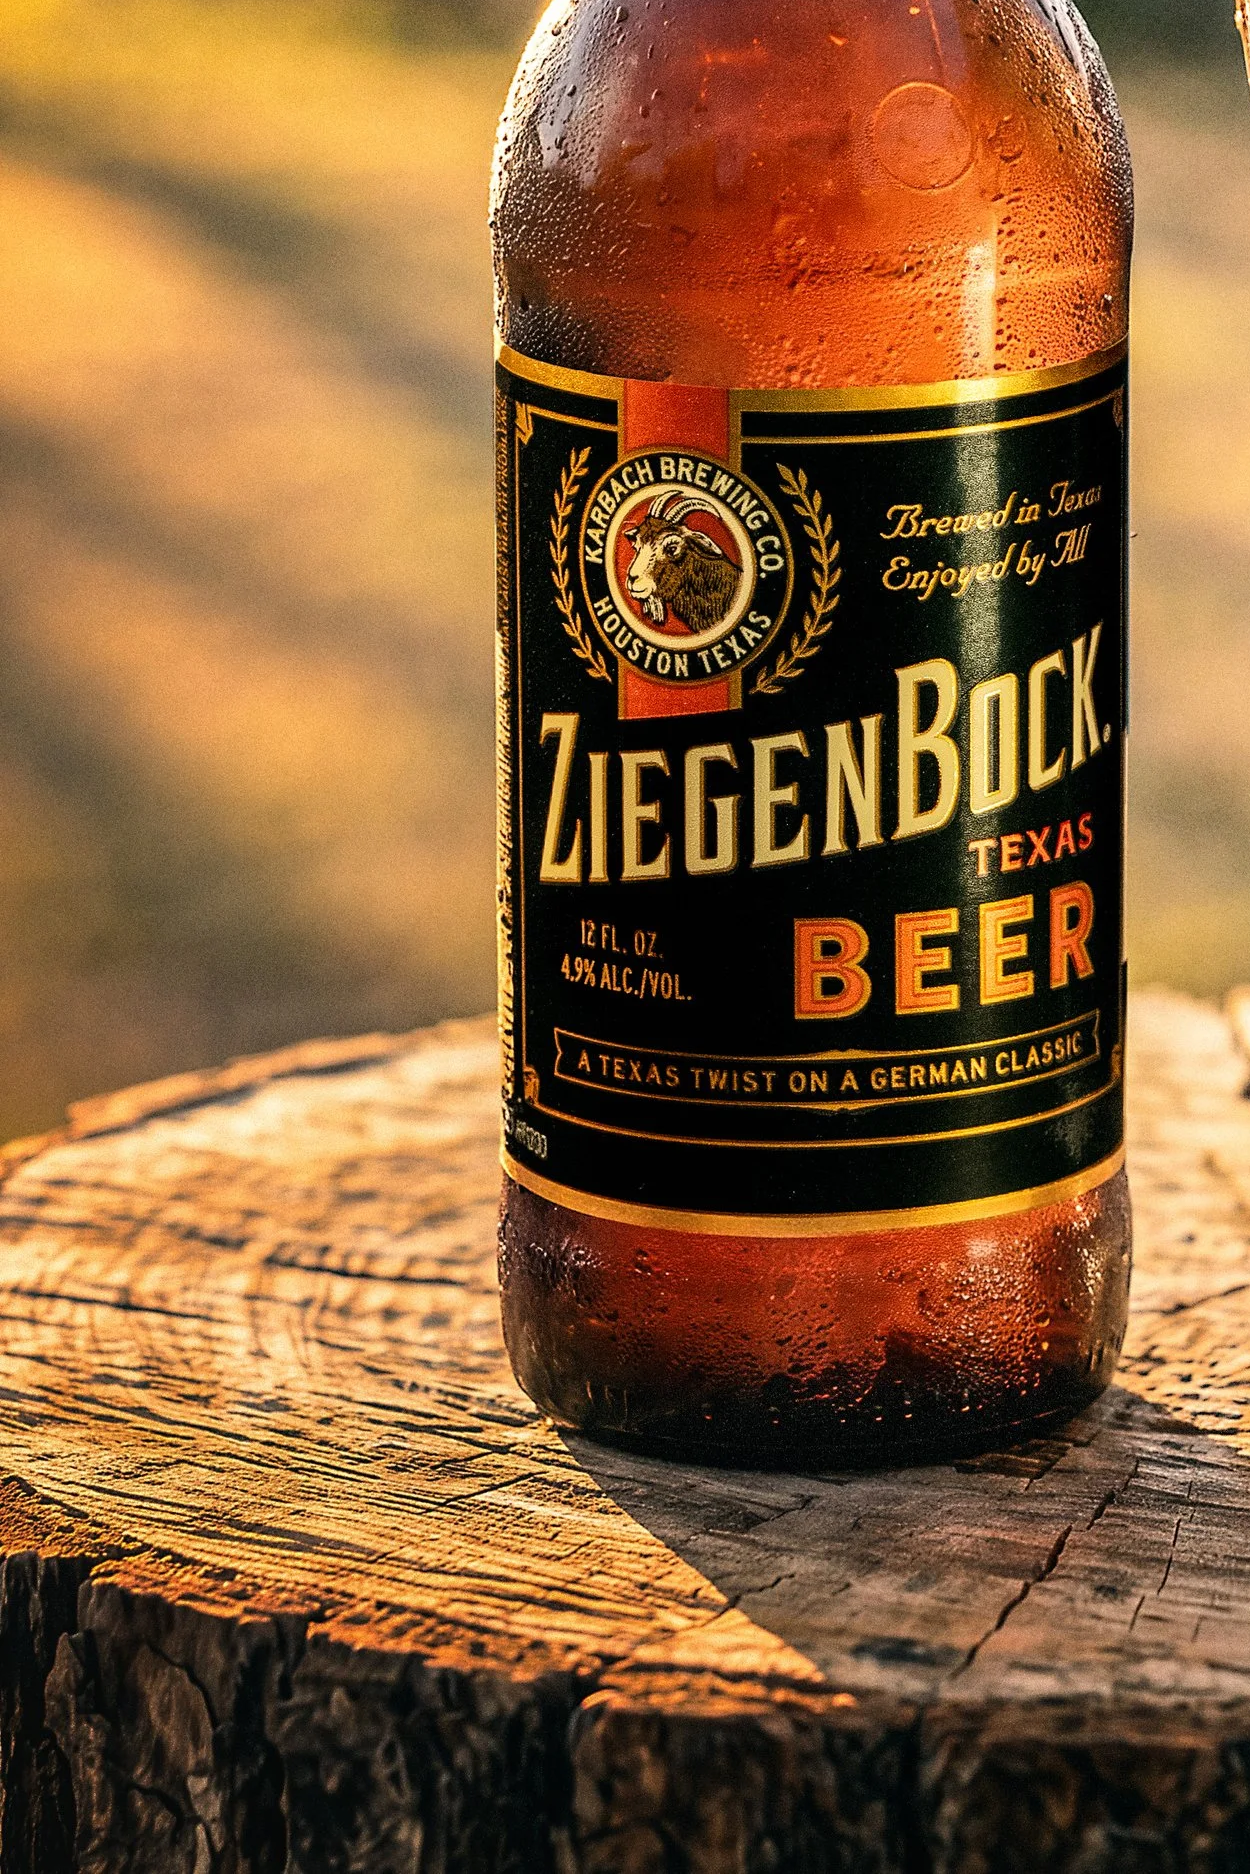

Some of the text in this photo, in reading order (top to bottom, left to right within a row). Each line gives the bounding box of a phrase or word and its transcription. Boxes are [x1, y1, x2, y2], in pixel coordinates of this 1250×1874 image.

[585, 456, 785, 580] KARBACH BREWING CO.
[880, 490, 1018, 540] Brewed
[1014, 497, 1042, 525] in
[882, 522, 1092, 602] Enjoyed by All
[594, 595, 772, 677] HOUSTON TEXAS
[968, 812, 1094, 878] TEXAS
[580, 917, 664, 959] 12 FL. OZ.
[793, 879, 1098, 1021] BEER
[560, 953, 693, 1001] 4.9% ALC./VOL.
[577, 1030, 1084, 1094] A TEXAS TWIST ON A GERMAN CLASSIC
